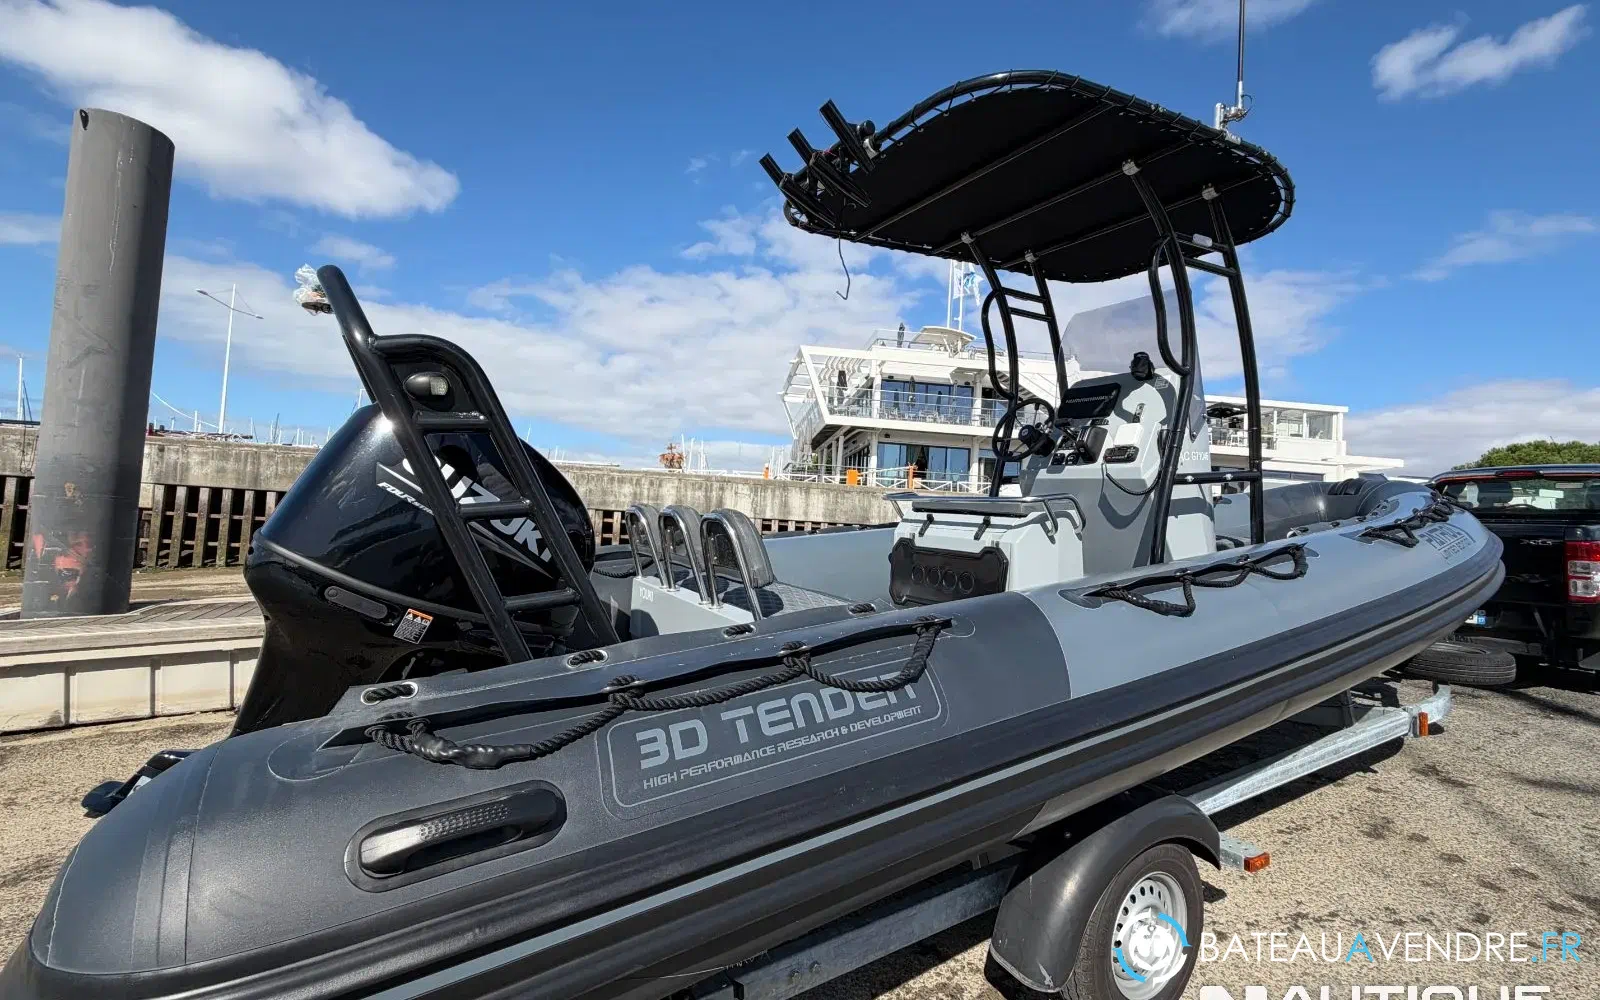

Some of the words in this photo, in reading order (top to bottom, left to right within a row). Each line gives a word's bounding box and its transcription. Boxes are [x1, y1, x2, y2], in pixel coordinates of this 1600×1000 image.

[377, 482, 416, 503] FOUR
[636, 719, 708, 770] 3D
[642, 772, 678, 789] HIGH
[680, 746, 776, 781] PERFORMANCE
[777, 728, 840, 753] RESEARCH
[841, 725, 850, 735] &
[849, 705, 922, 733] DEVELOPMENT
